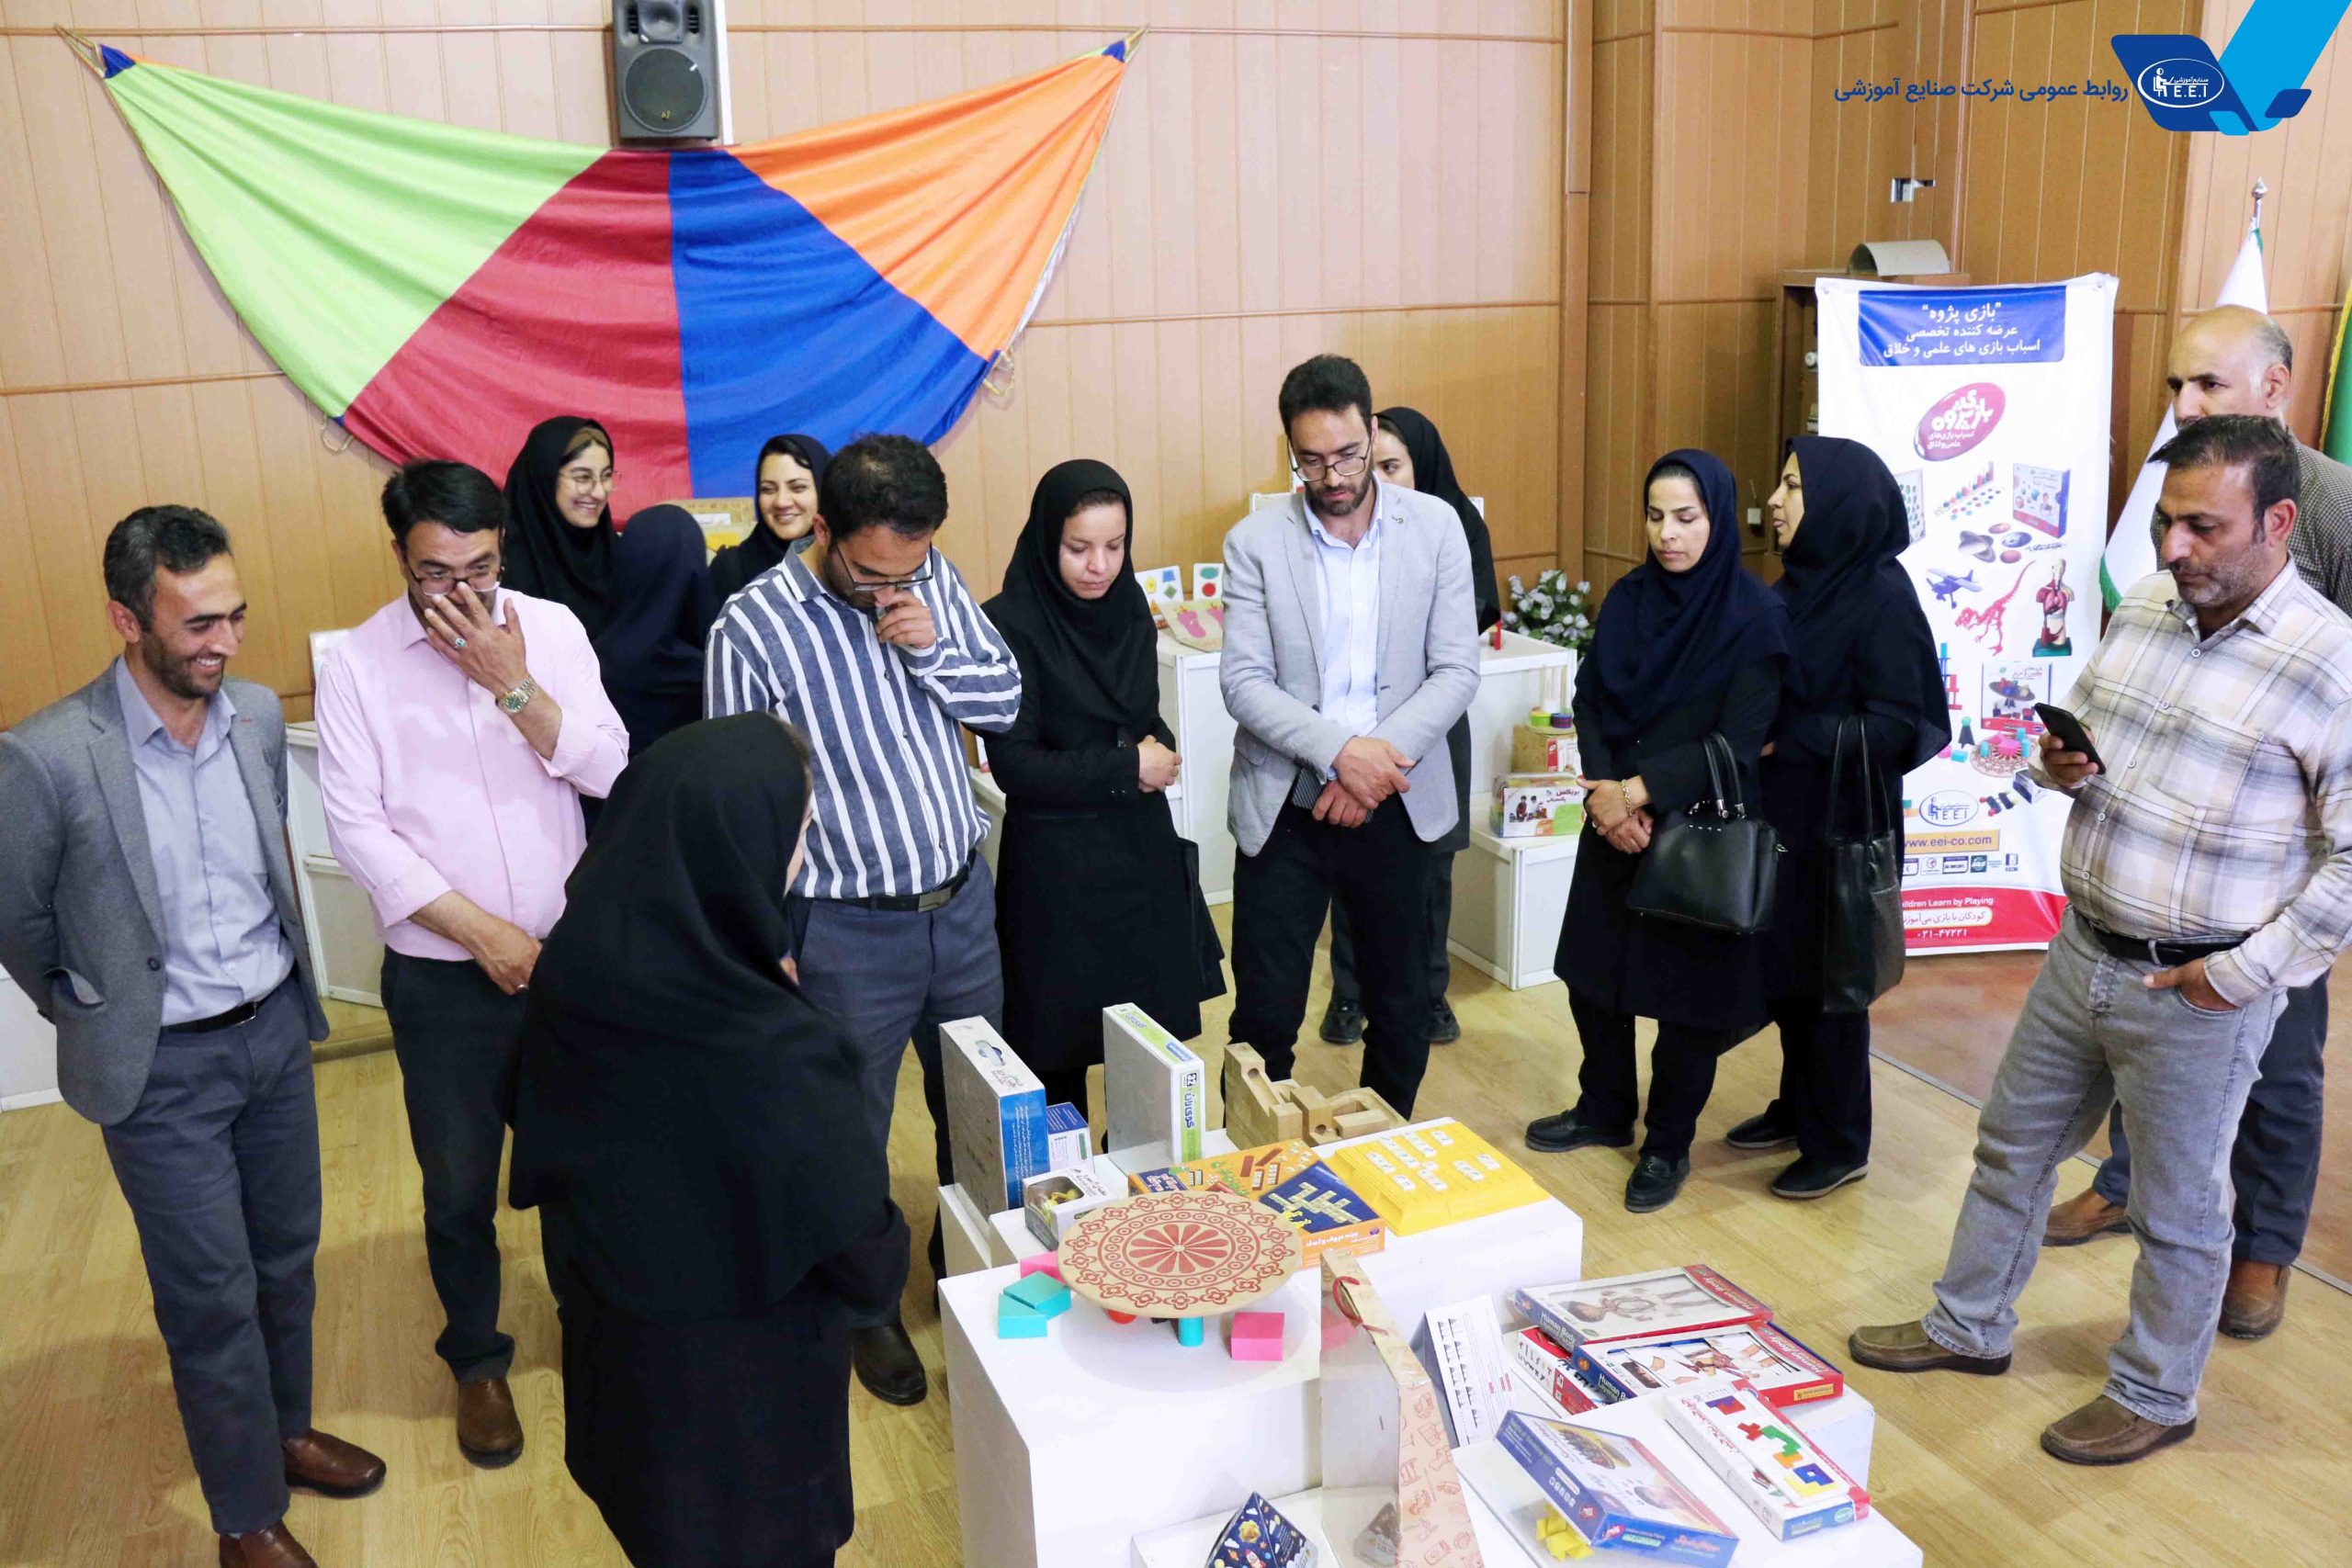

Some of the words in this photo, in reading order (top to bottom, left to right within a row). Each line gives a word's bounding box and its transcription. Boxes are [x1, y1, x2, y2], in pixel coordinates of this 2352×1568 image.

[1906, 326, 1950, 342] تخصصی
[1954, 324, 1983, 337] کننده
[1986, 324, 2018, 338] عرضه
[1883, 341, 1910, 357] خلاق
[1914, 345, 1920, 356] و
[1923, 341, 1951, 358] علمی
[1954, 341, 1975, 355] های
[1979, 341, 2004, 355] بازی
[2007, 339, 2041, 354] اسباب
[1953, 898, 1963, 907] by
[1965, 897, 1994, 906] Playing
[1543, 1312, 1561, 1331] Human
[1770, 1336, 1792, 1353] Body
[1792, 1351, 1827, 1372] Human
[1600, 1373, 1620, 1396] Human
